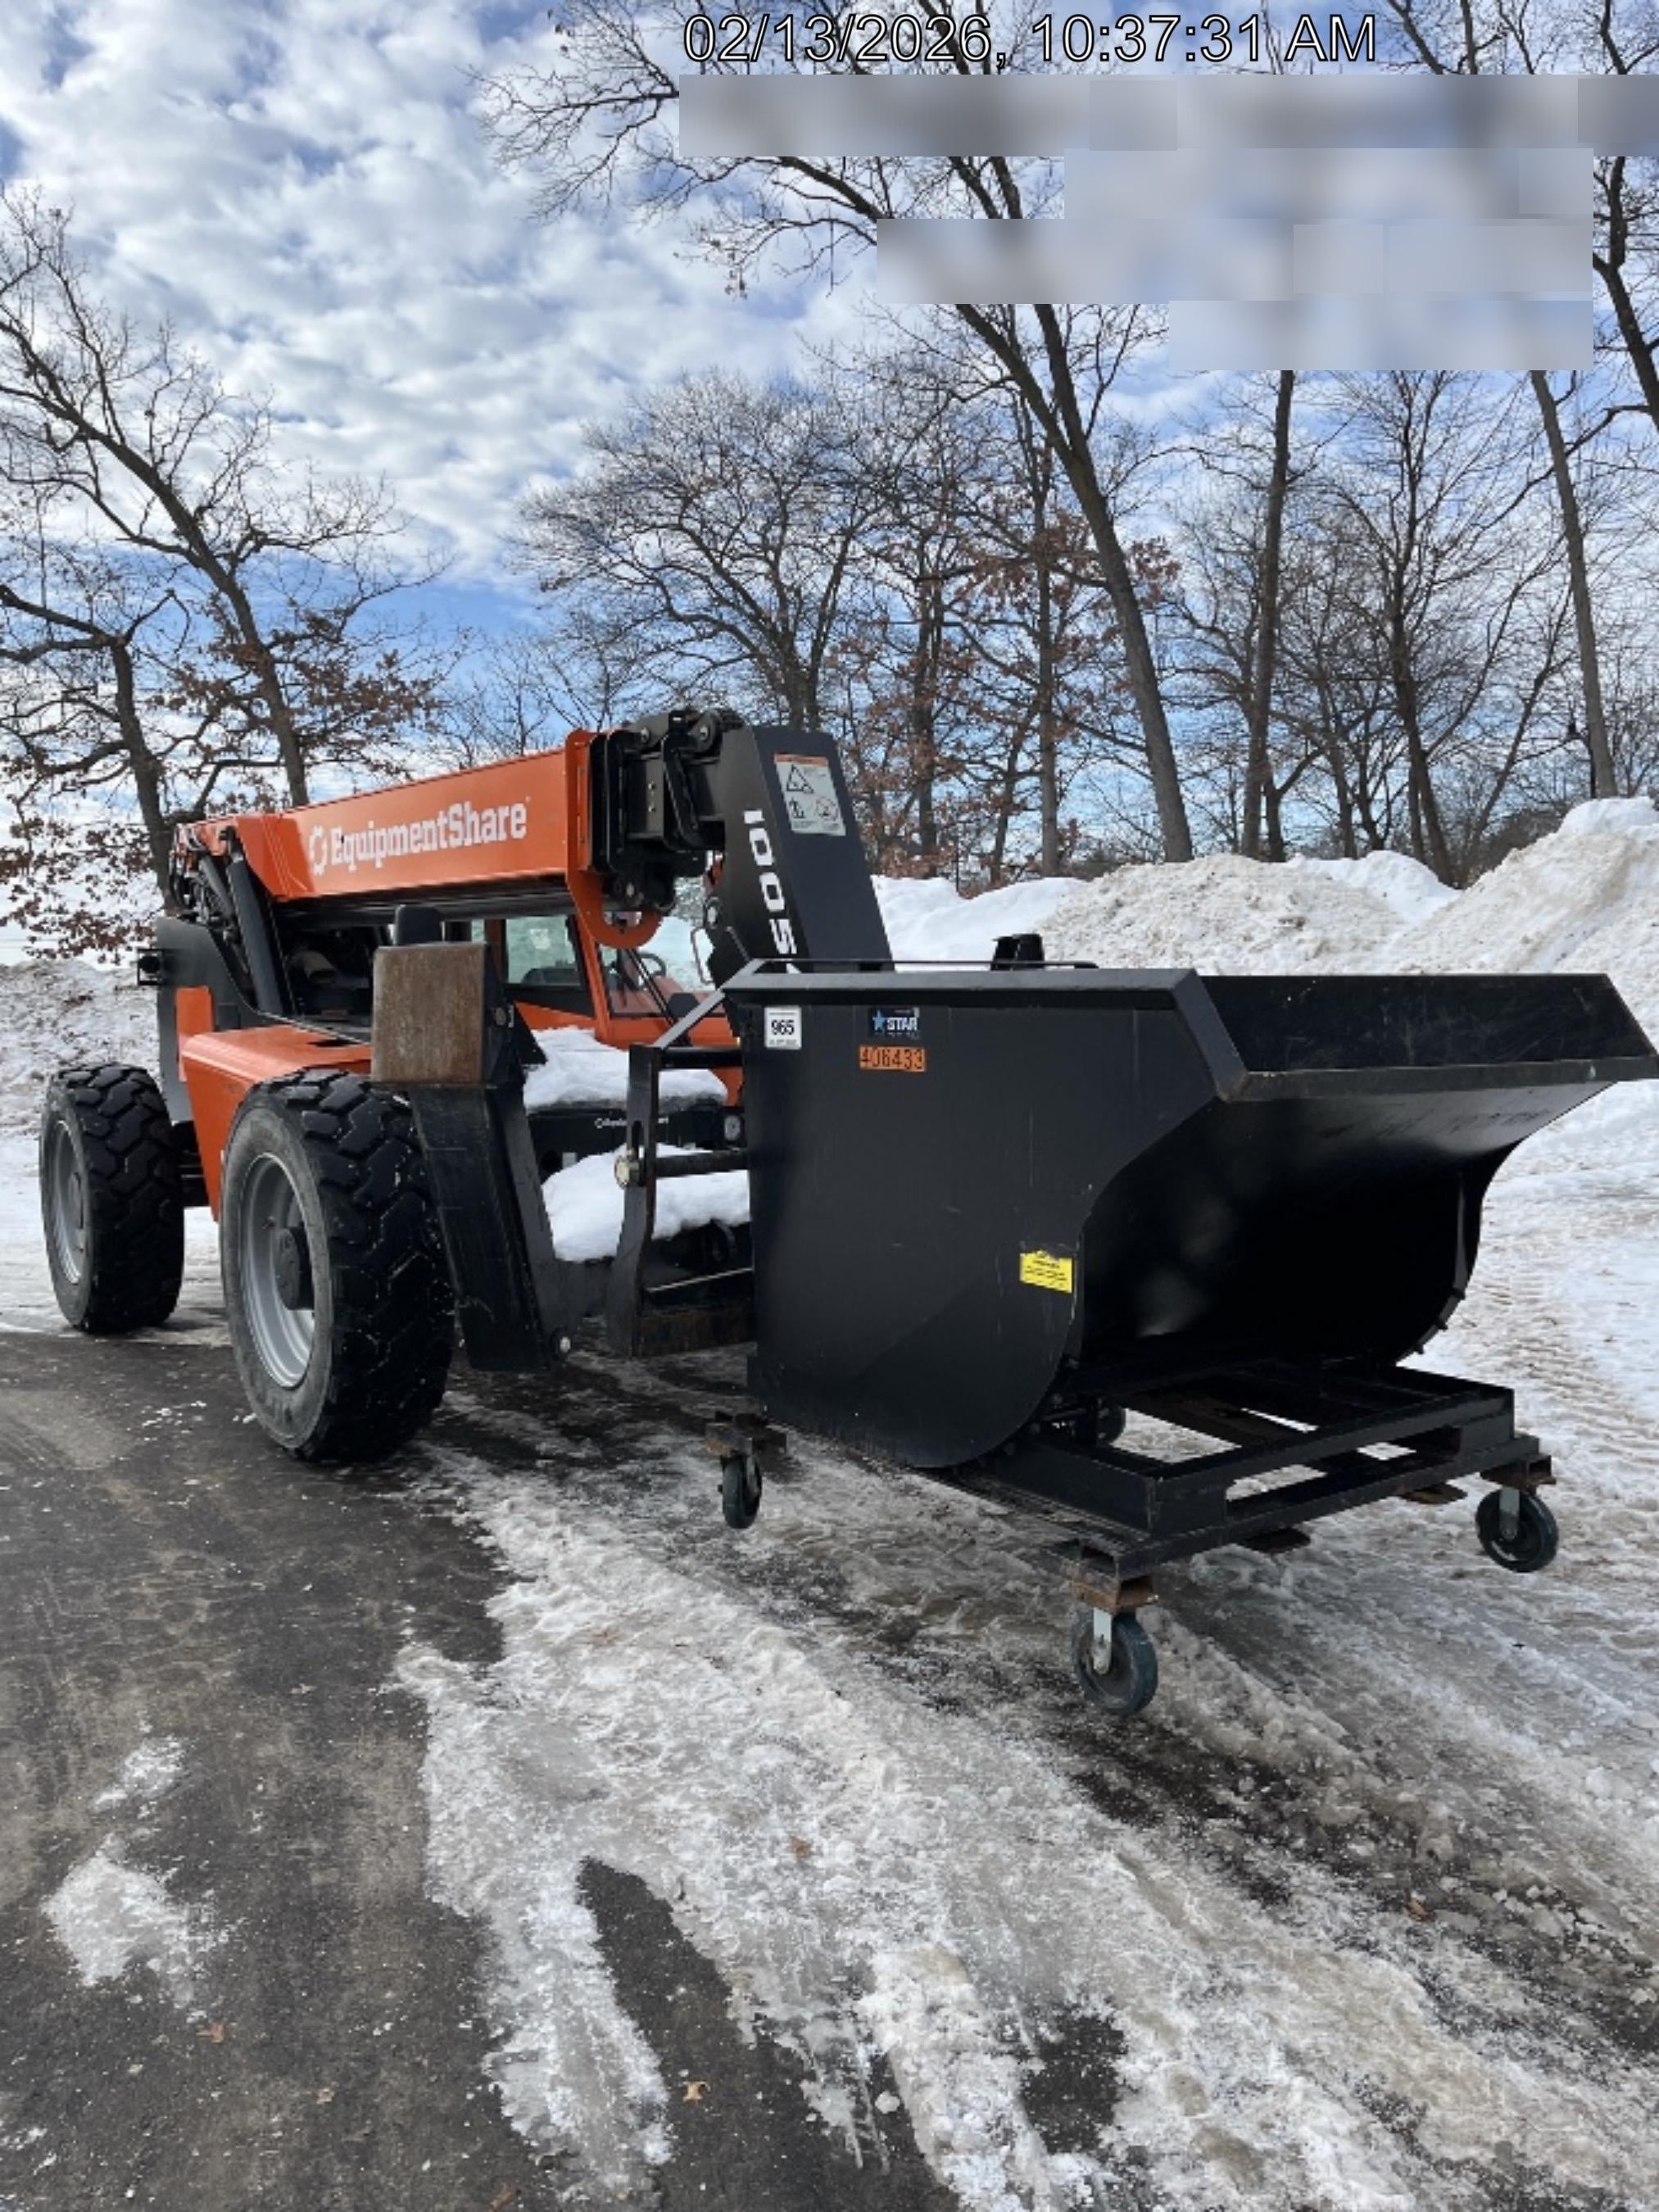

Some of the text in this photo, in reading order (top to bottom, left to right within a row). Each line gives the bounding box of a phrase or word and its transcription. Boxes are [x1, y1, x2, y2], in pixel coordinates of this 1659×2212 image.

[331, 801, 527, 871] EquipmentShare
[770, 1019, 796, 1036] 965
[886, 1017, 918, 1031] STAR
[860, 1048, 922, 1070] 406433
